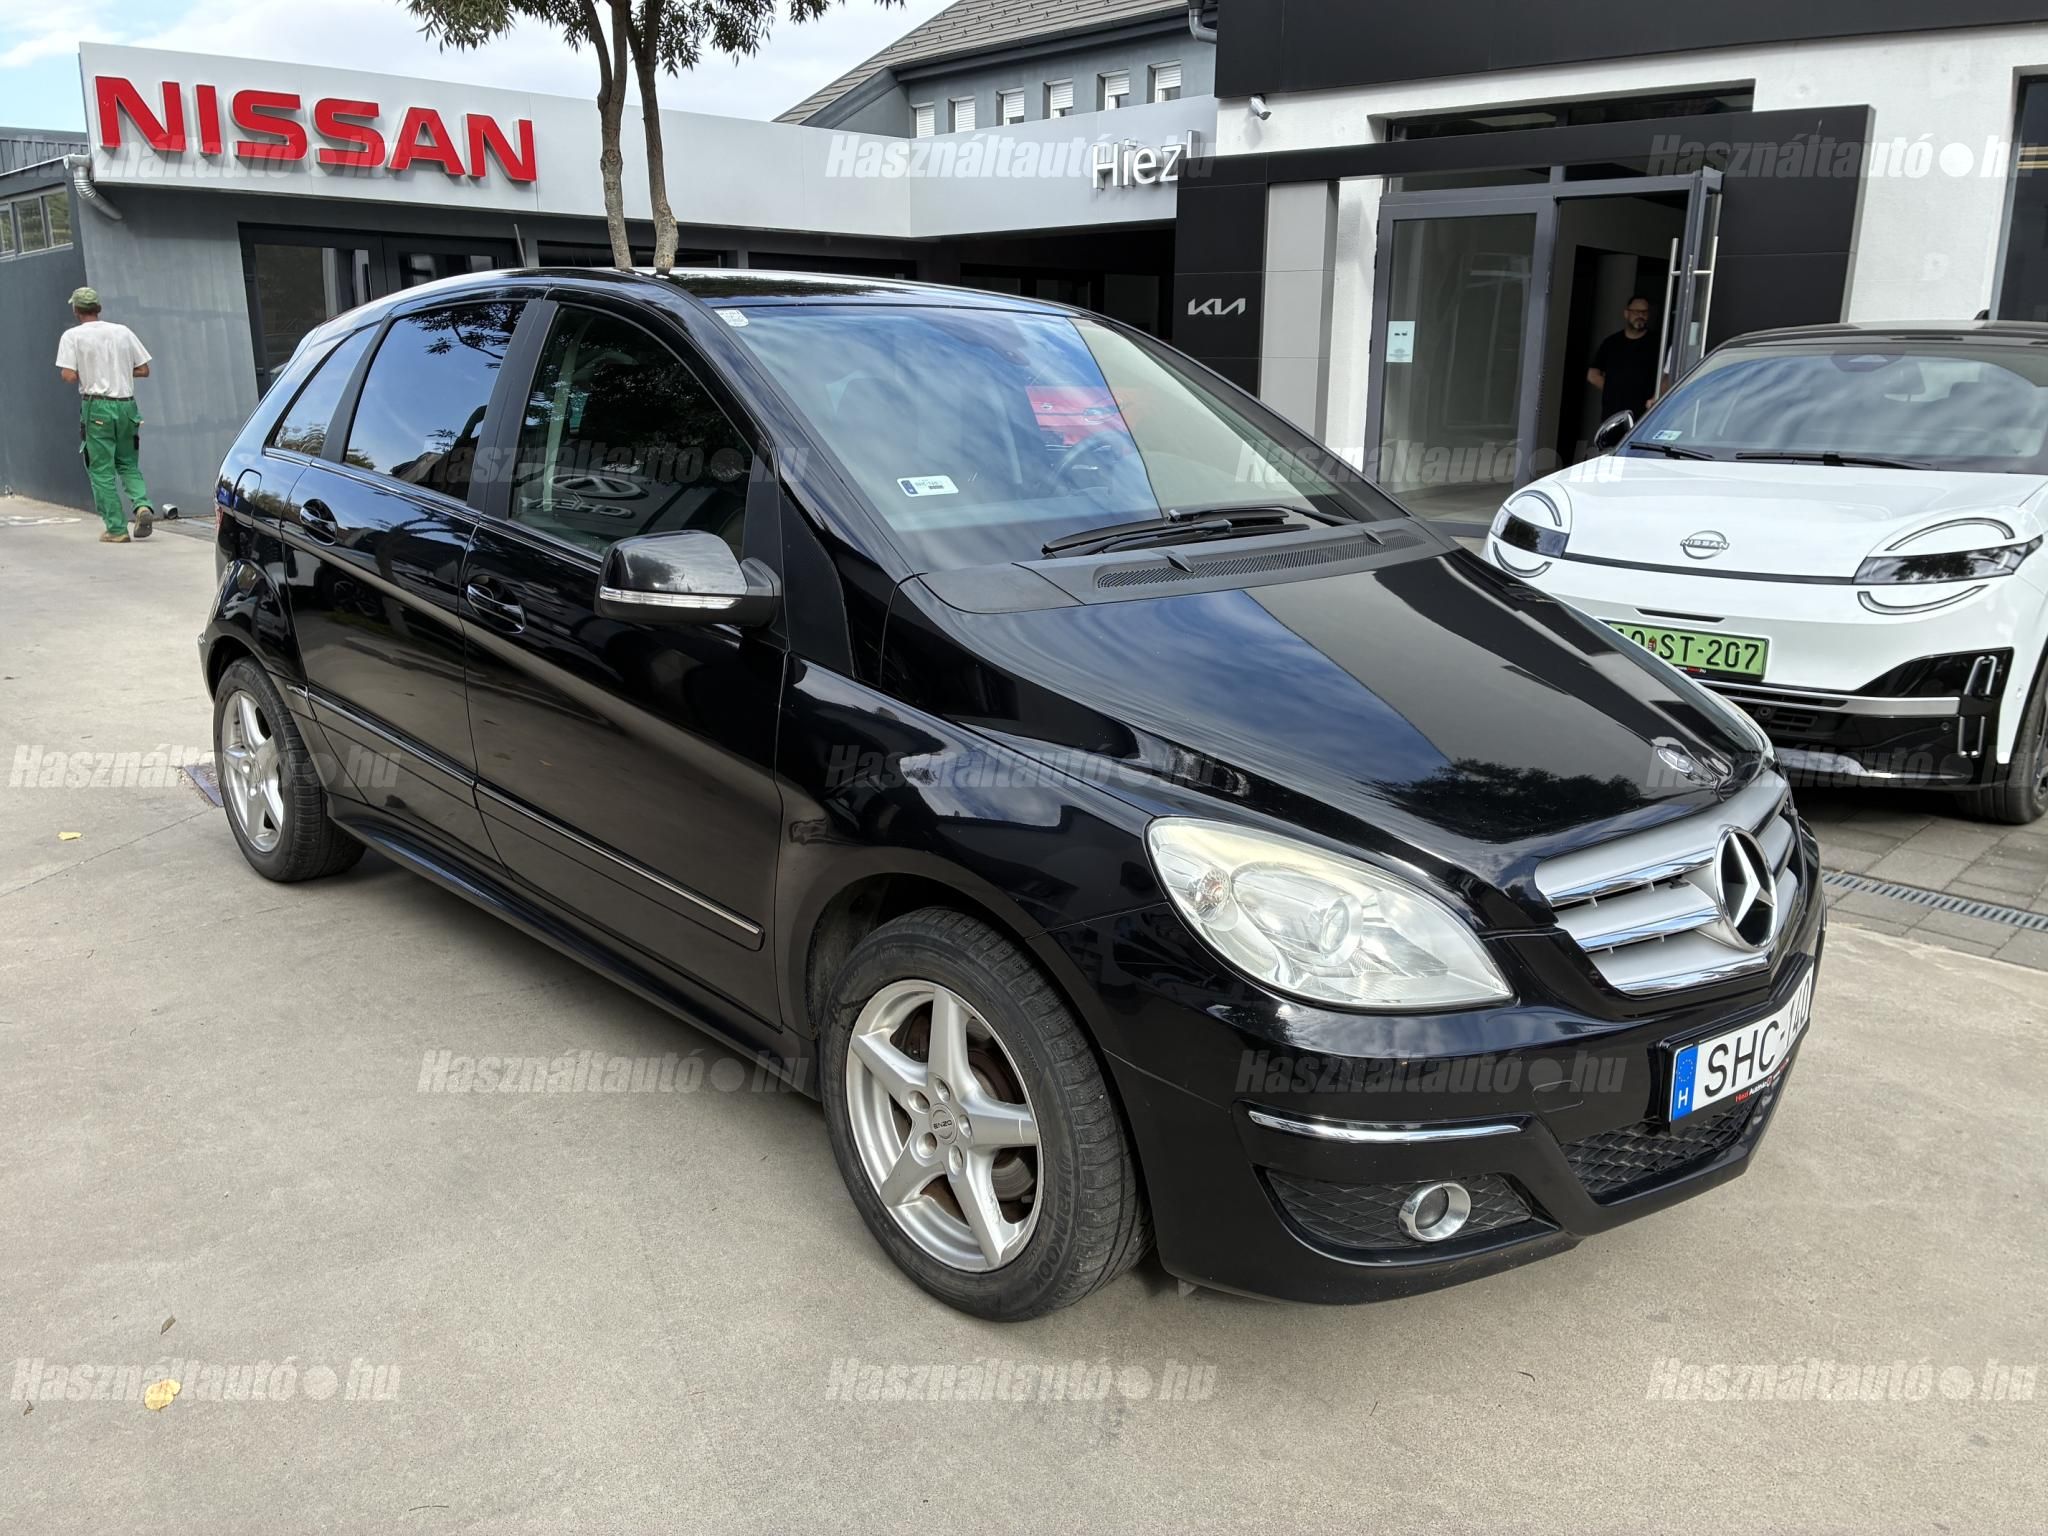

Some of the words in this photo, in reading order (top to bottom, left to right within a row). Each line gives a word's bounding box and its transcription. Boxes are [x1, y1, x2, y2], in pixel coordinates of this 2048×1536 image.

[94, 75, 538, 183] NISSAN
[1092, 129, 1200, 190] Hiezl
[1187, 297, 1246, 316] KIA
[1680, 538, 1730, 550] NISSAN
[1677, 1087, 1689, 1110] H
